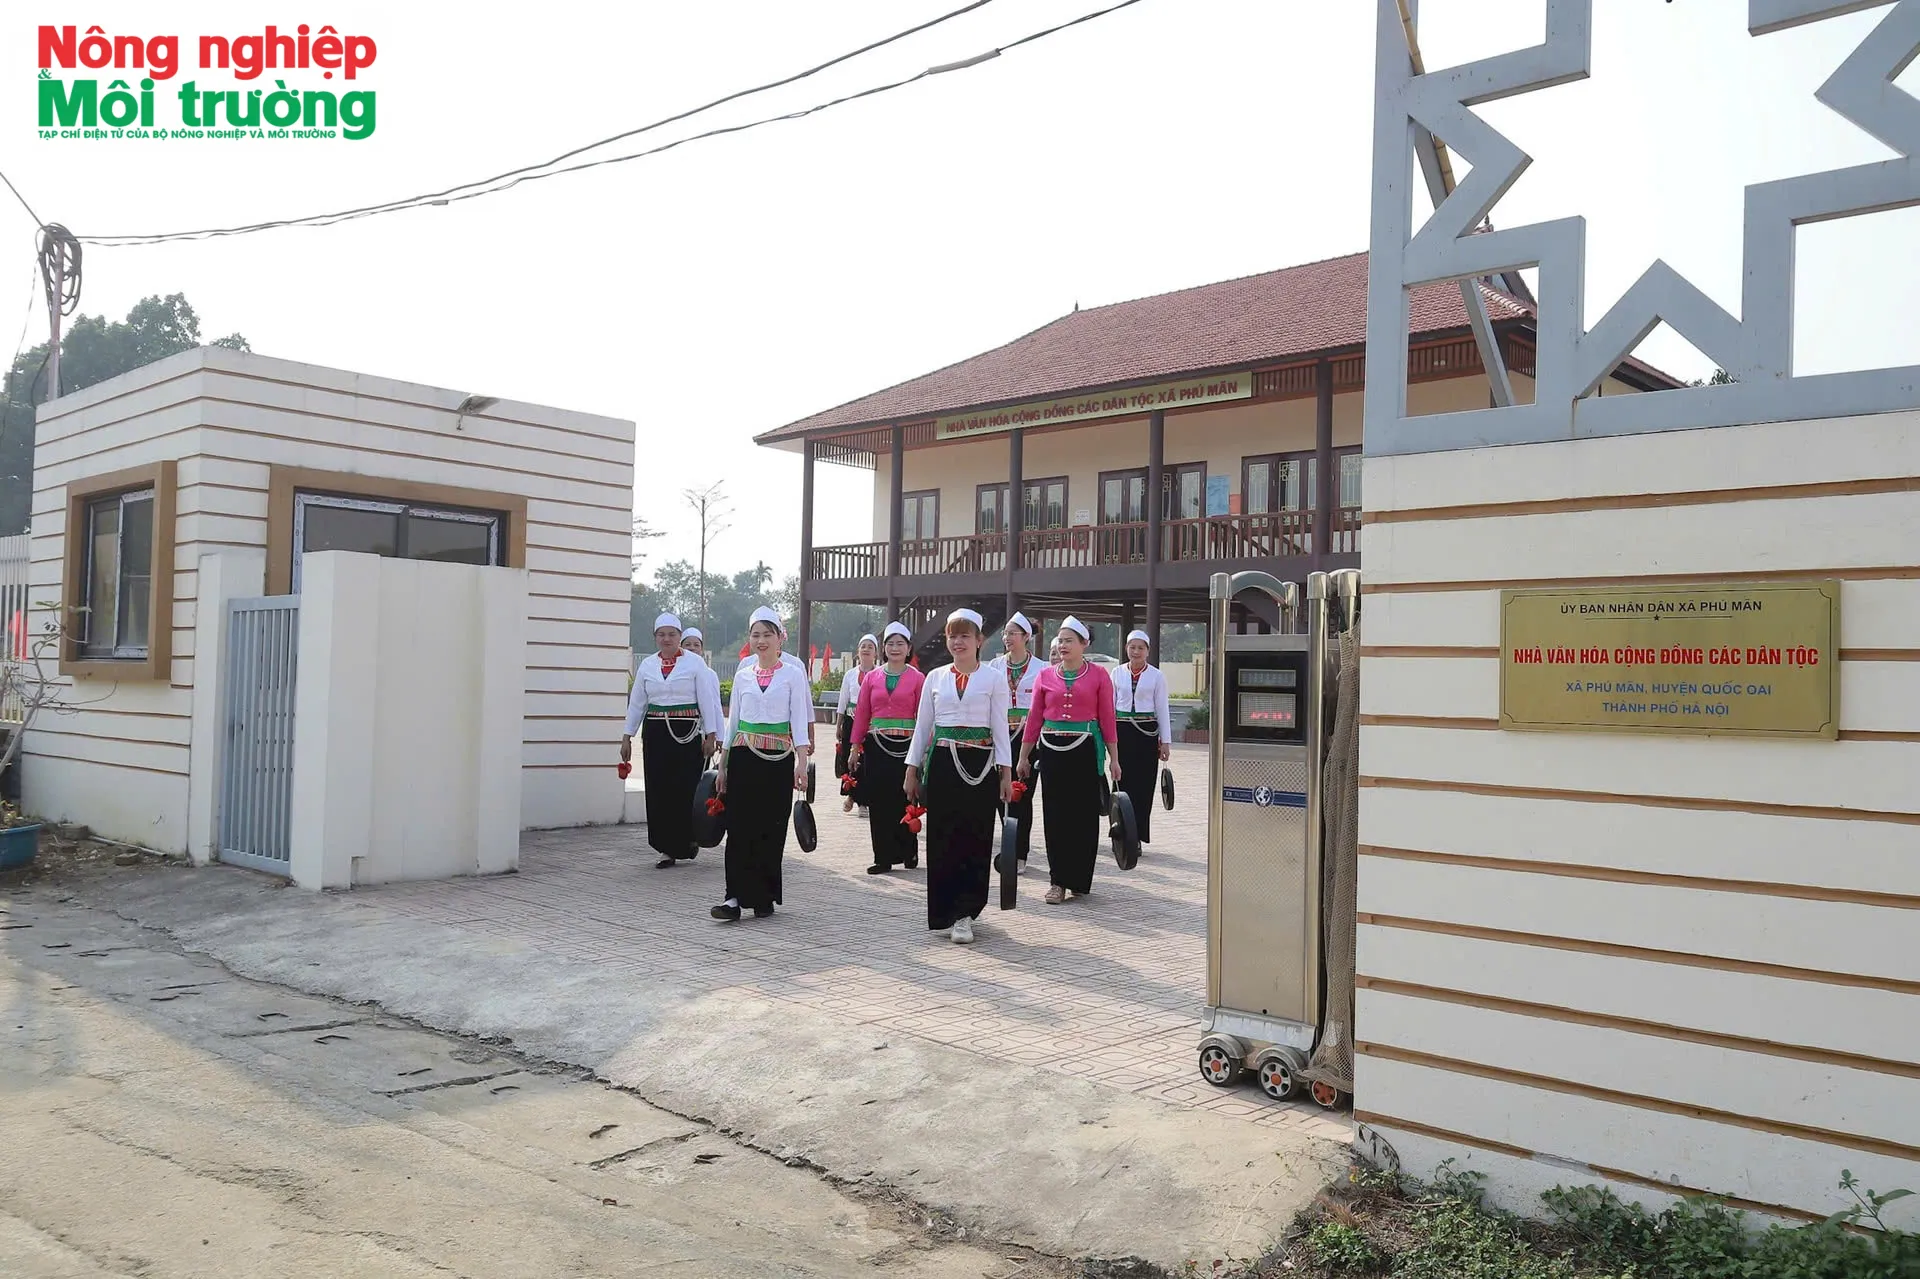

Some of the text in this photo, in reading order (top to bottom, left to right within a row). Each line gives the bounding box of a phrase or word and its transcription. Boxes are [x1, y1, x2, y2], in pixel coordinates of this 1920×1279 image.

[989, 413, 1010, 427] HÓA
[1077, 399, 1100, 414] CÁC
[1102, 396, 1127, 411] DÂN
[1130, 392, 1154, 409] TỘC
[1158, 388, 1177, 403] XÃ
[1179, 383, 1204, 401] PHÚ
[1207, 380, 1238, 397] MÃN
[1560, 599, 1762, 614] ỦY BAN NHÂN DÂN XÃ PHÚ MÃN
[1514, 642, 1819, 669] NHÀ VĂN HÓA CỘNG ĐỒNG CÁC DÂN TỘC
[1566, 679, 1771, 696] XÃ PHÚ MÃN, HUYỆN QUỐC OAI
[1602, 699, 1729, 718] THÀNH PHỐ HÀ NỘI
